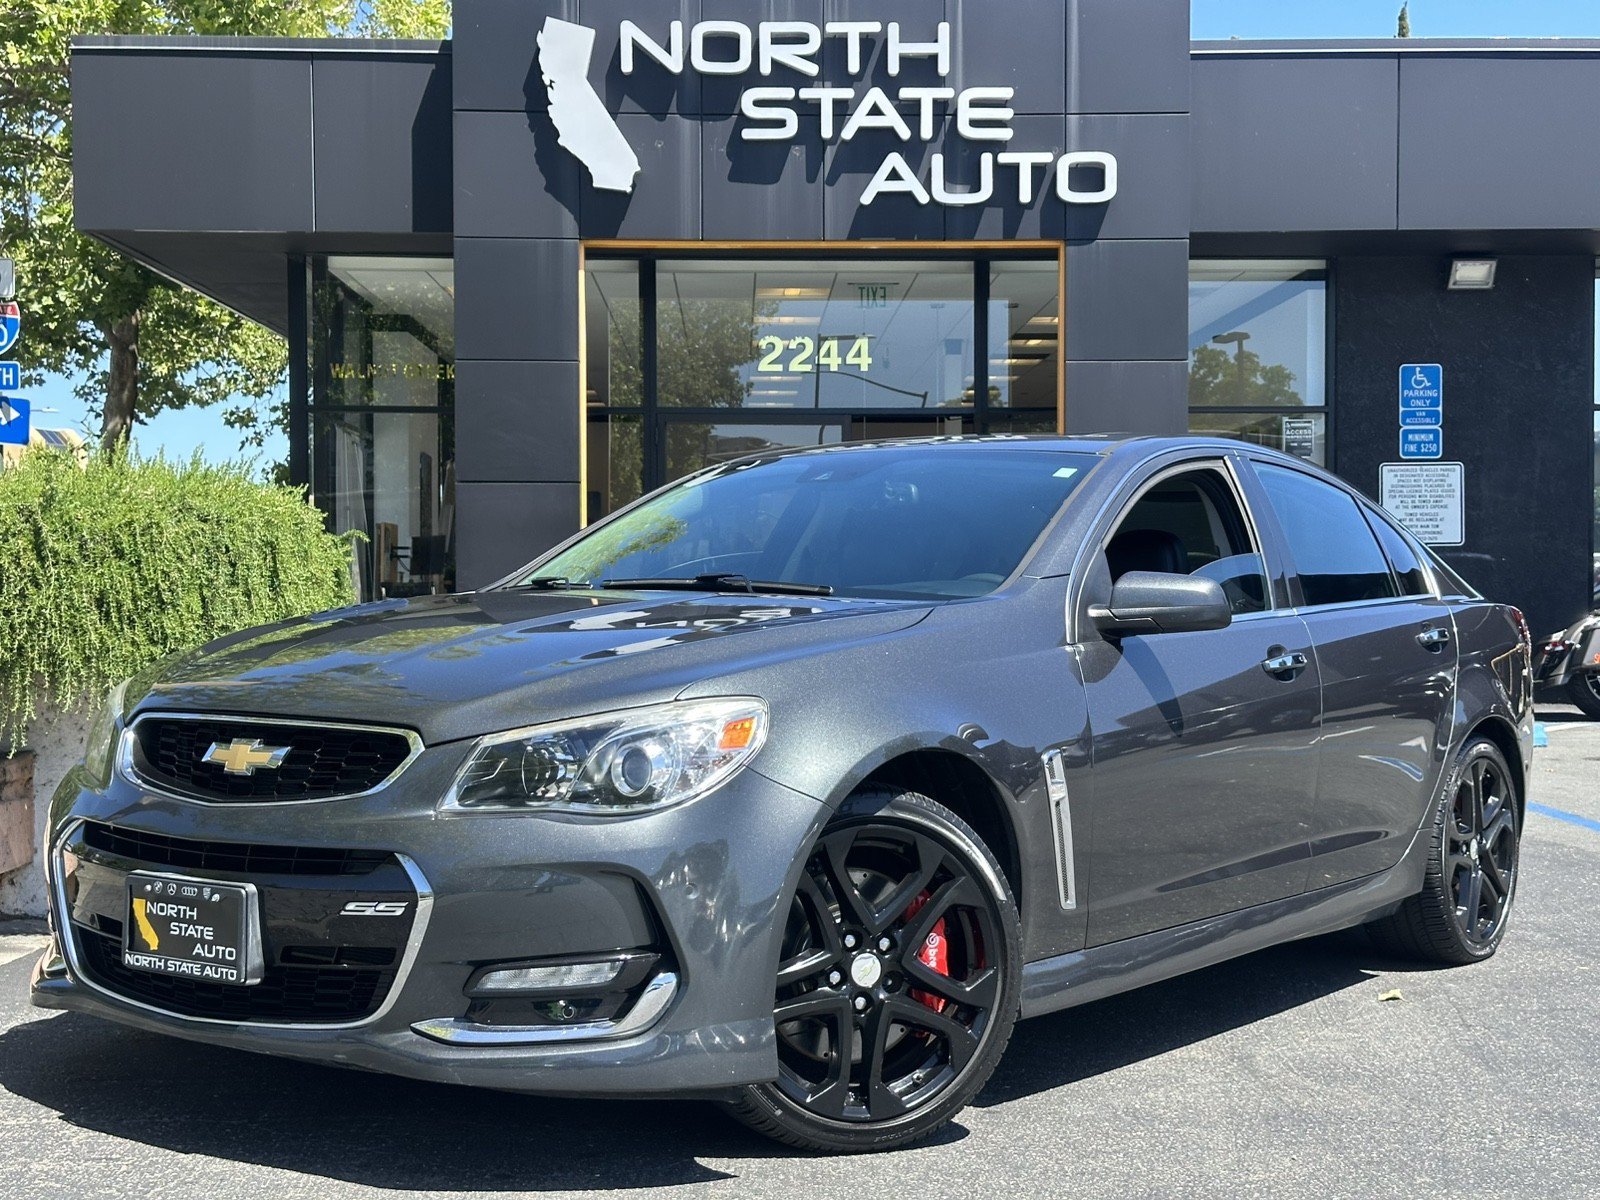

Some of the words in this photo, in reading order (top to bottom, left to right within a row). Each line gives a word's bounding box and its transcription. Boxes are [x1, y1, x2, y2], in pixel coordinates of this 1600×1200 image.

[619, 19, 950, 77] NORTH
[741, 86, 1014, 141] STATE
[859, 151, 1118, 206] AUTO
[757, 335, 873, 372] 2244
[1403, 389, 1438, 397] PARKING
[1407, 433, 1434, 441] MINIMUM
[1404, 443, 1418, 452] FINE
[1420, 443, 1438, 452] $250
[146, 901, 197, 920] NORTH
[340, 901, 409, 916] SS
[169, 922, 214, 940] STATE
[192, 943, 236, 961] AUTO
[124, 953, 165, 970] NORTH
[167, 960, 202, 976] STATE
[202, 965, 238, 981] AUTO
